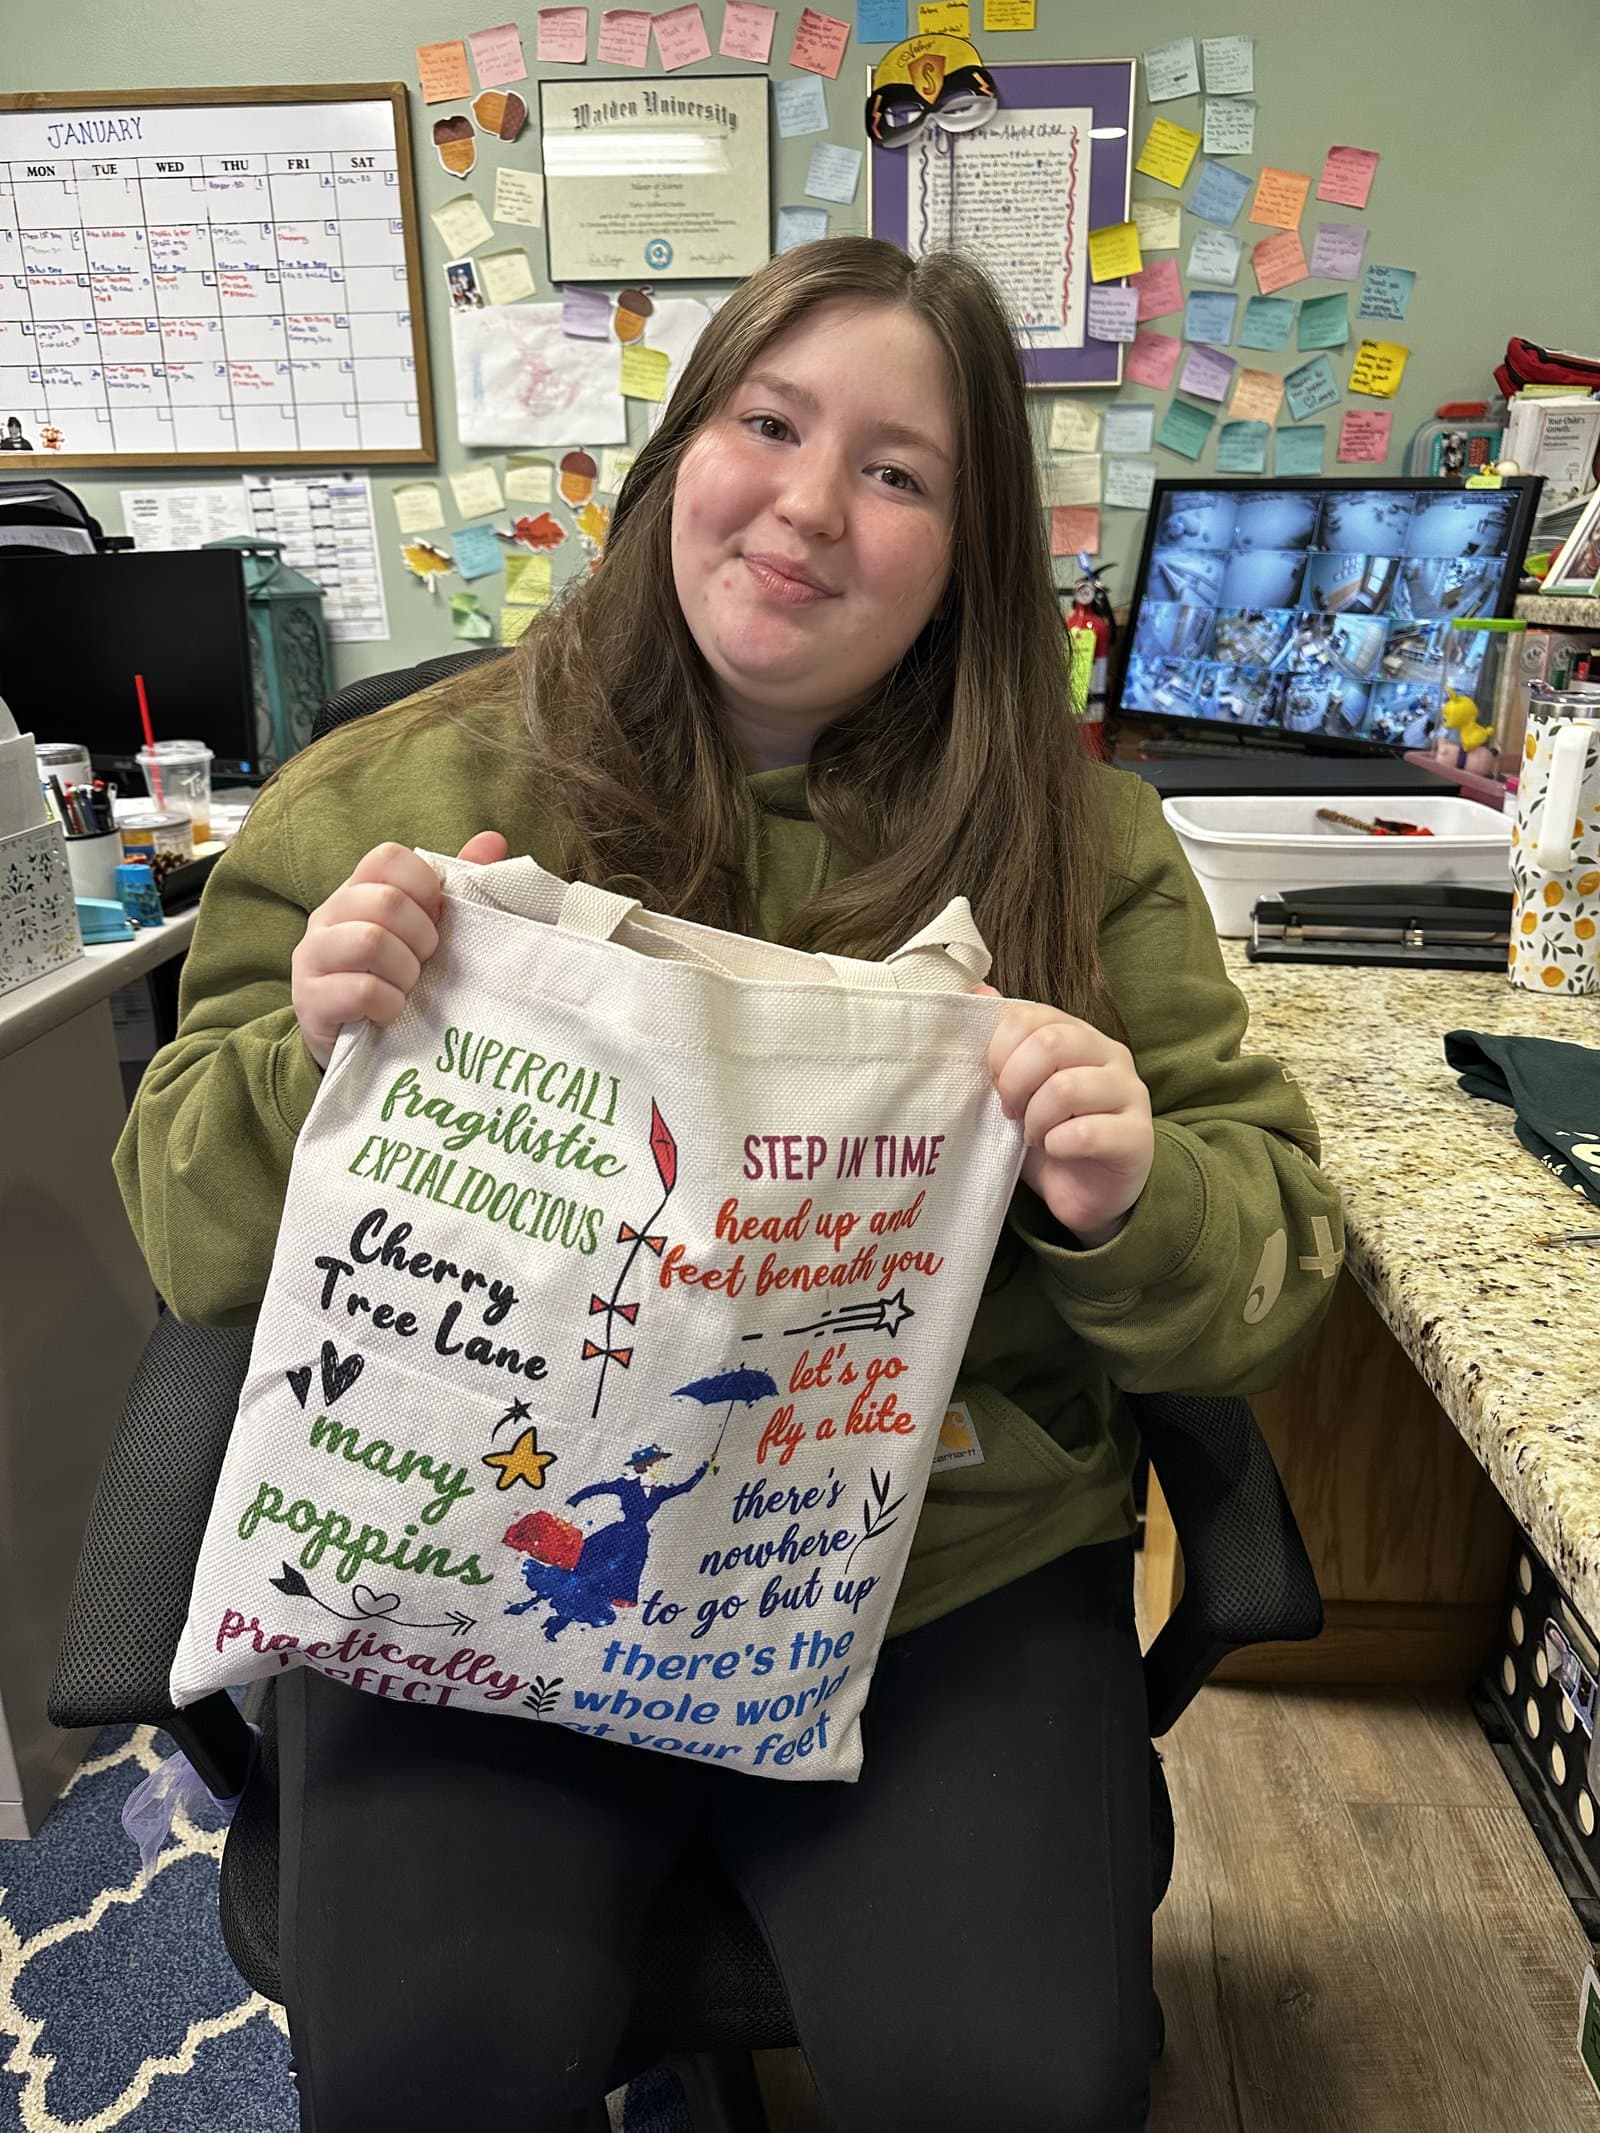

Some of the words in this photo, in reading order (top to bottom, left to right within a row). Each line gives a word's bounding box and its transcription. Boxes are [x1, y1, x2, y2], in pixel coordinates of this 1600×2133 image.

[921, 62, 937, 96] S
[47, 116, 143, 149] JANUARY
[571, 99, 637, 131] Walden
[642, 90, 738, 132] University
[27, 165, 56, 177] MON
[92, 164, 118, 176] TUE
[156, 162, 184, 173] WED
[221, 159, 249, 171] THU
[288, 158, 310, 170] FRI
[351, 157, 376, 168] SAT
[436, 1026, 620, 1126] SUPERCALI
[381, 1067, 627, 1178] fragilistic
[743, 1134, 828, 1181] STEP
[837, 1136, 868, 1179] IN
[874, 1134, 946, 1178] TIME
[348, 1135, 604, 1256] EXPIALIDOCIOUS
[715, 1197, 813, 1245] head
[815, 1212, 860, 1252] up
[869, 1189, 926, 1234] and
[349, 1207, 519, 1326] Cherry
[659, 1243, 748, 1298] feet
[755, 1243, 877, 1297] beneath
[876, 1250, 944, 1291] you
[314, 1255, 418, 1337] Tree
[434, 1300, 548, 1381] Lane
[788, 1342, 858, 1394] let's
[862, 1356, 909, 1400] go
[756, 1403, 807, 1466] fly
[815, 1414, 837, 1441] a
[845, 1393, 916, 1437] kite
[309, 1414, 476, 1525] mary
[732, 1466, 847, 1525] there's
[237, 1481, 494, 1586] poppins
[698, 1523, 857, 1577] nowhere
[641, 1589, 686, 1626] to
[690, 1594, 748, 1640] go
[759, 1566, 824, 1618] but
[833, 1575, 880, 1615] up
[215, 1607, 530, 1701] practically
[600, 1639, 776, 1682] there's
[789, 1628, 855, 1670] the
[573, 1688, 720, 1726] whole
[735, 1665, 850, 1727] world
[752, 1710, 832, 1767] feet
